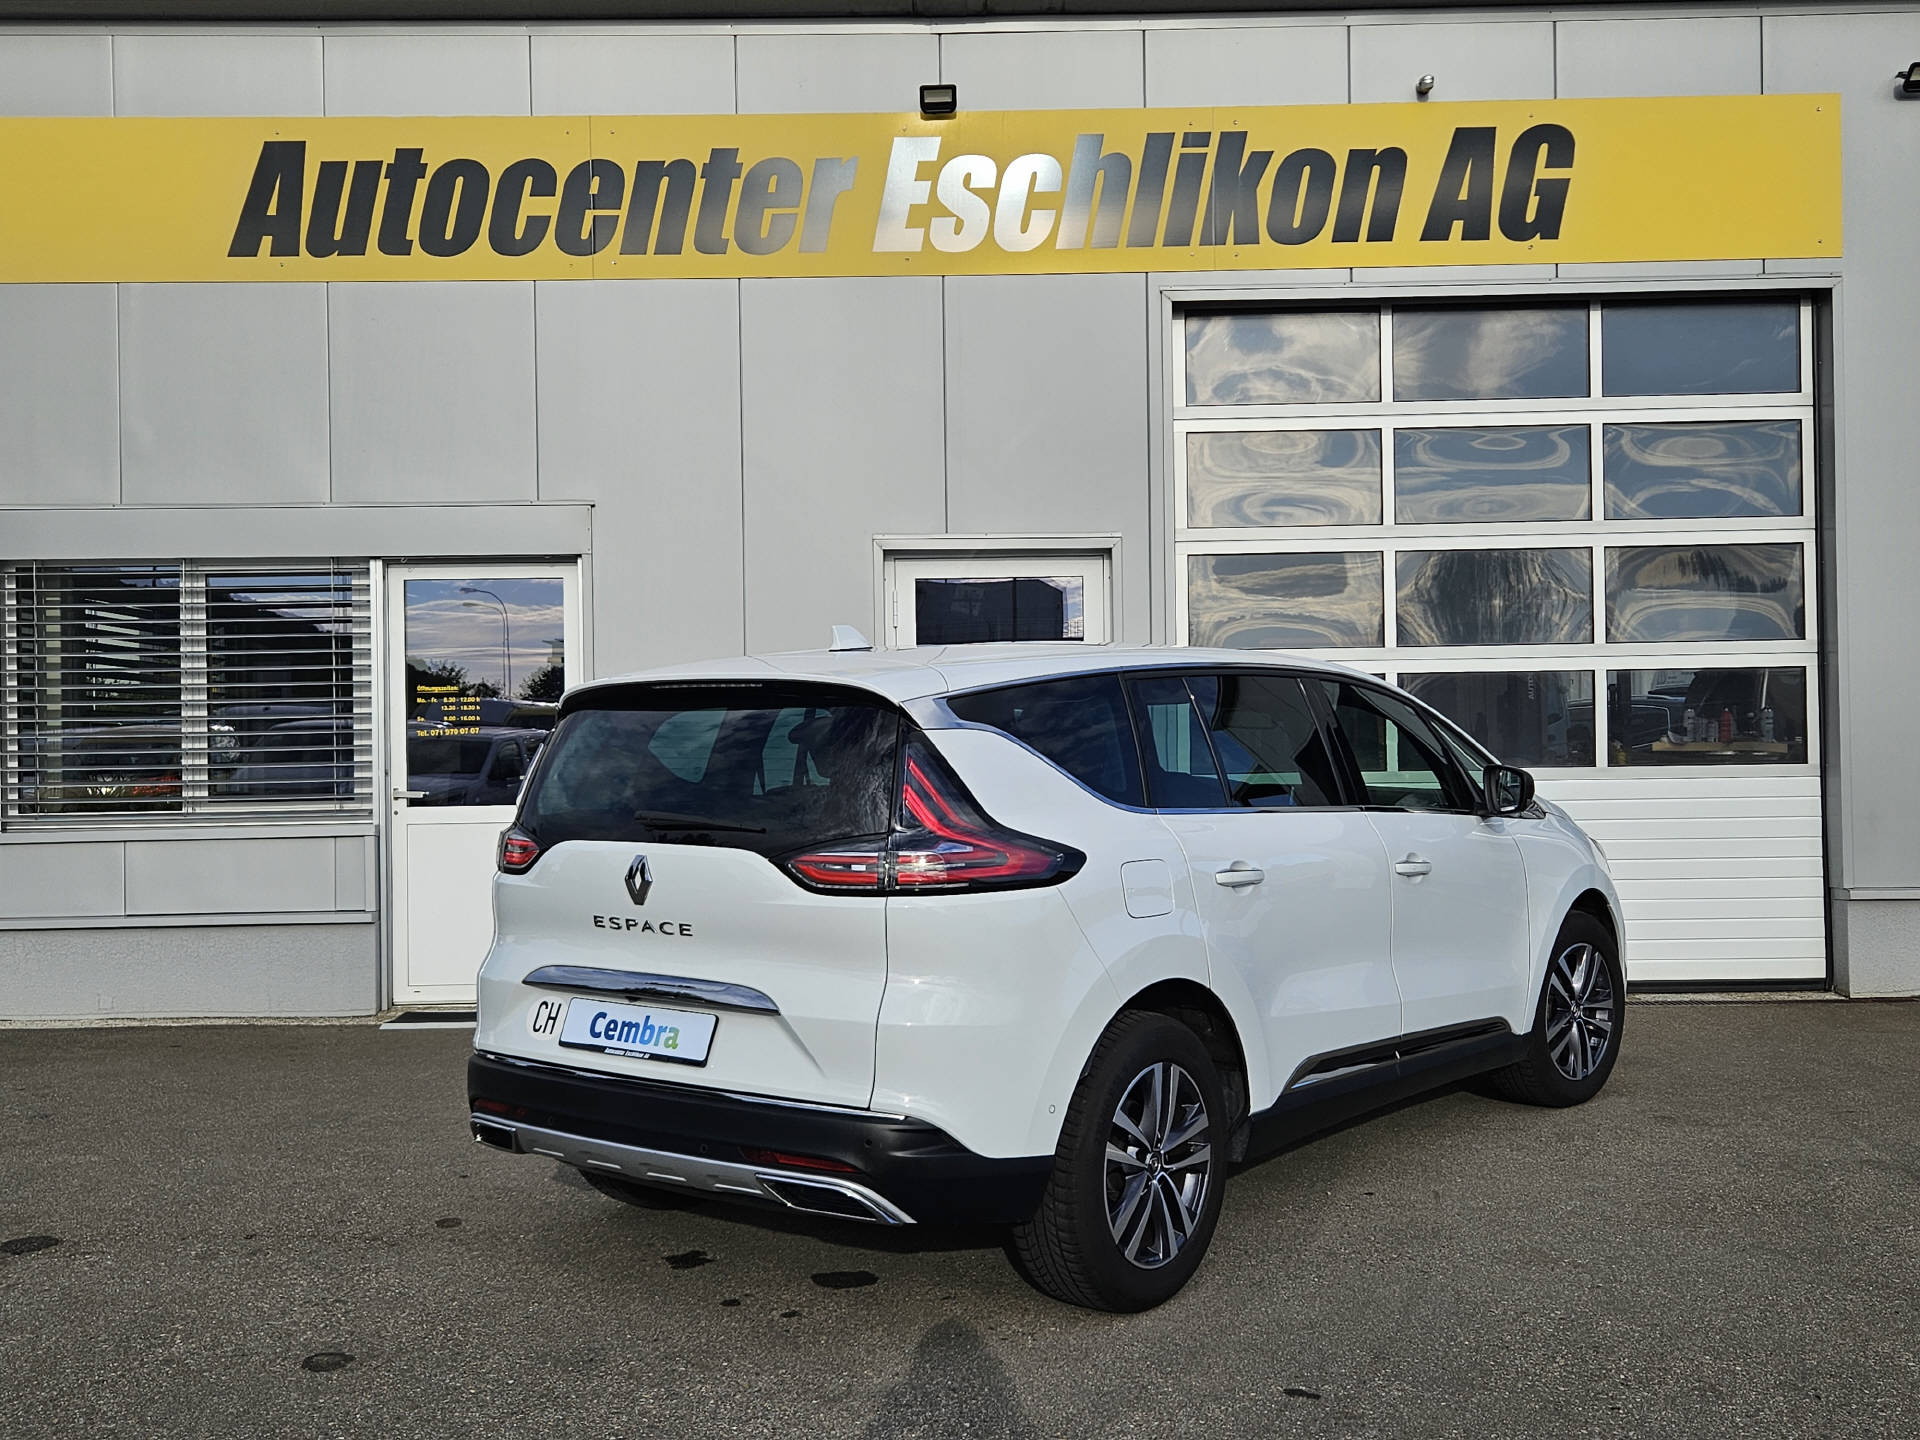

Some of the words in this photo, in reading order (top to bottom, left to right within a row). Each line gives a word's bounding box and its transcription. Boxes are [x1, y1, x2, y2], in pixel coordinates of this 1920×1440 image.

[227, 140, 859, 258] Autocenter
[873, 130, 1408, 253] Eschlikon
[1420, 123, 1576, 243] AG
[593, 915, 693, 937] ESPACE
[532, 1000, 562, 1035] CH
[589, 1011, 680, 1050] Cembra
